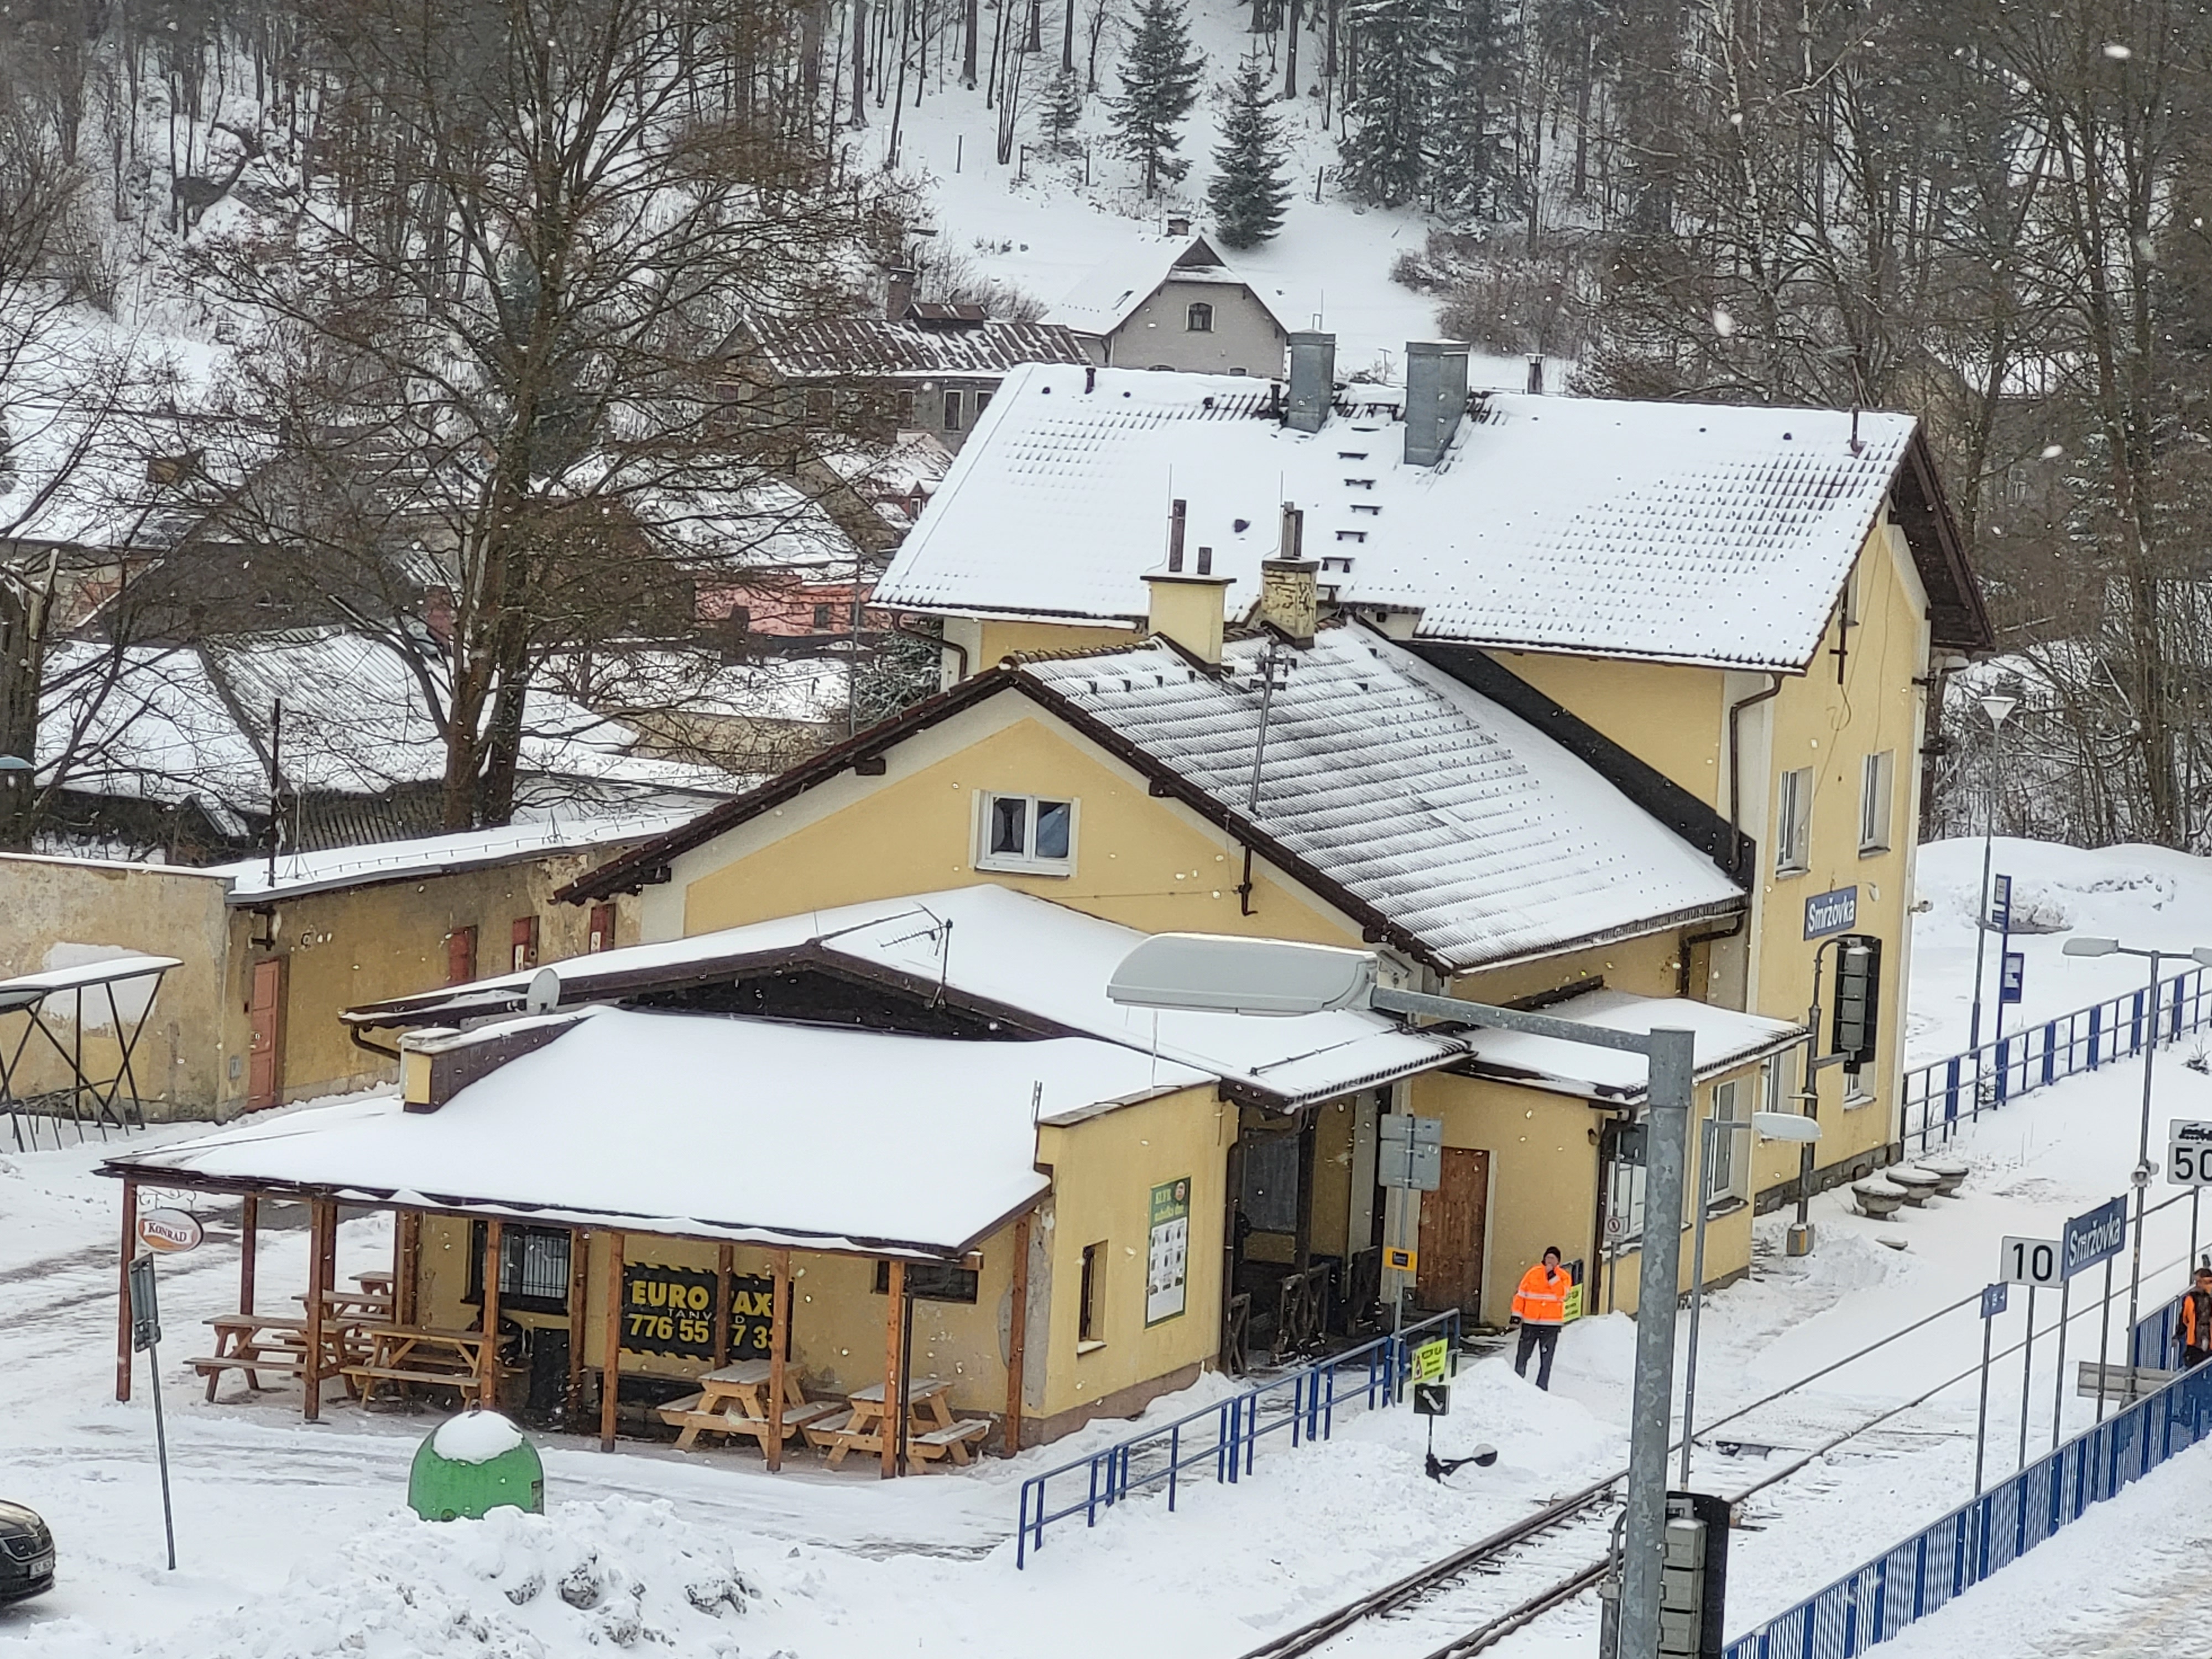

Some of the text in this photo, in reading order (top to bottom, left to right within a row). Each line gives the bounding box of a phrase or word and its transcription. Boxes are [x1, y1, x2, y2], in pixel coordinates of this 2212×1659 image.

[1808, 895, 1855, 933] Smržovka
[2174, 1147, 2212, 1182] 50
[148, 1222, 187, 1242] KONRAD
[2069, 1212, 2121, 1267] Smržovka
[2013, 1243, 2053, 1282] 10
[632, 1280, 773, 1317] EURO AX
[667, 1308, 745, 1324] TANVD
[629, 1314, 674, 1340] 776
[753, 1326, 773, 1349] 3
